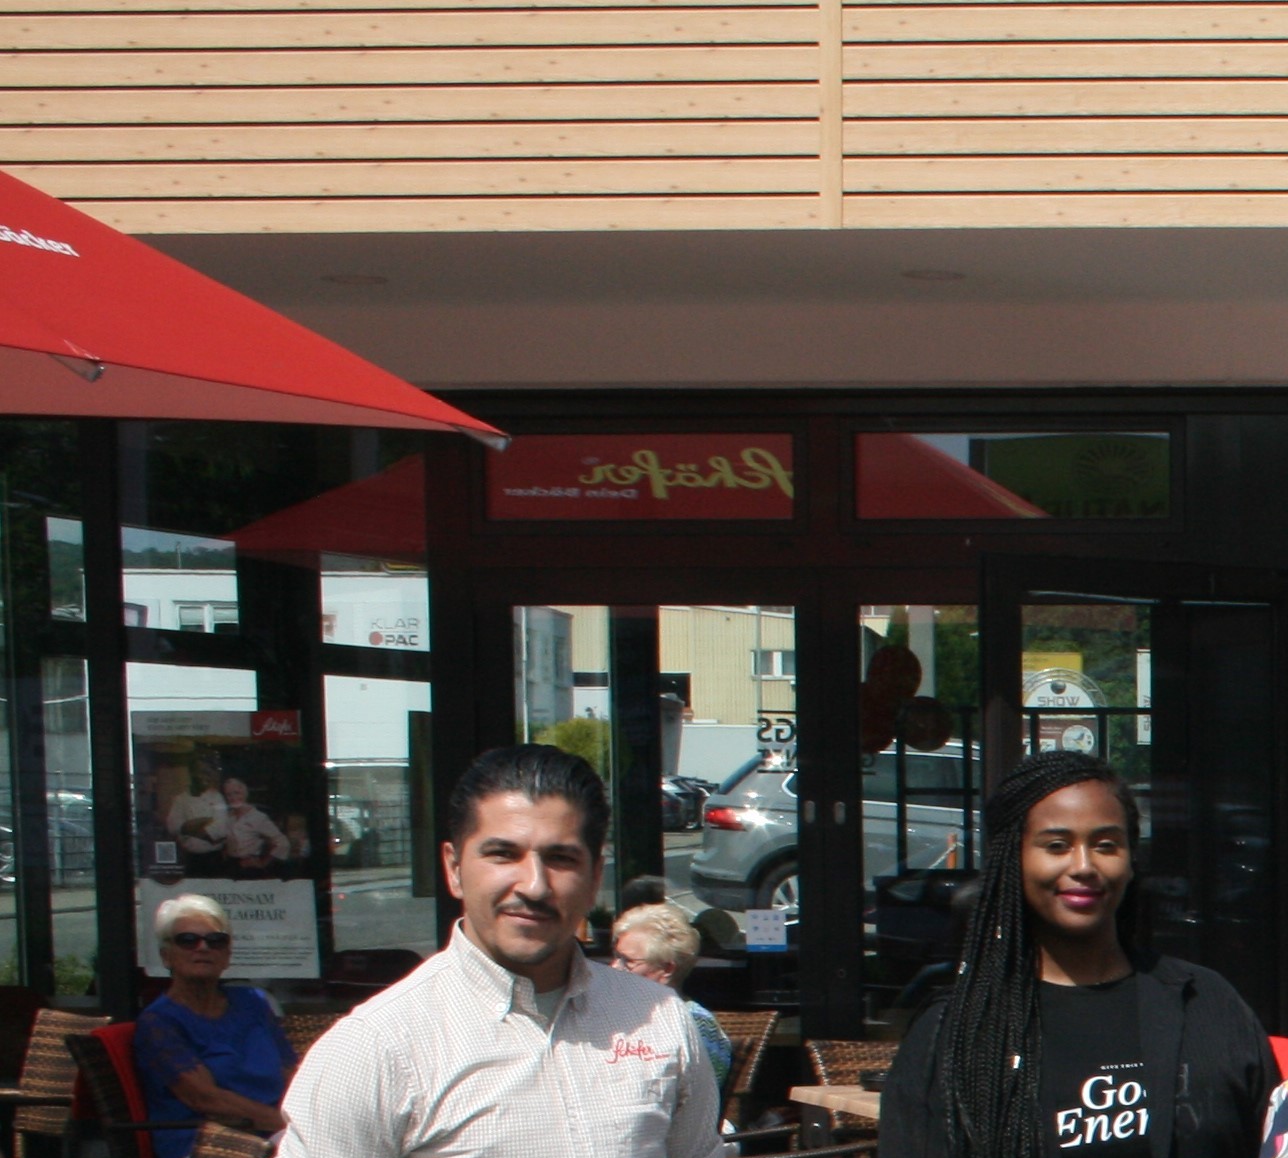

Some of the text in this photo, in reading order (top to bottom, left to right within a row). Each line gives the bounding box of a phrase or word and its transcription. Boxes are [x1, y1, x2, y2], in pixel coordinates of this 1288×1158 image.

[0, 225, 80, 257] äcker
[370, 617, 419, 630] KLAR
[384, 634, 419, 646] PAC
[1037, 696, 1080, 706] SHOW
[1080, 1075, 1147, 1110] Go
[1056, 1107, 1149, 1149] Ener
